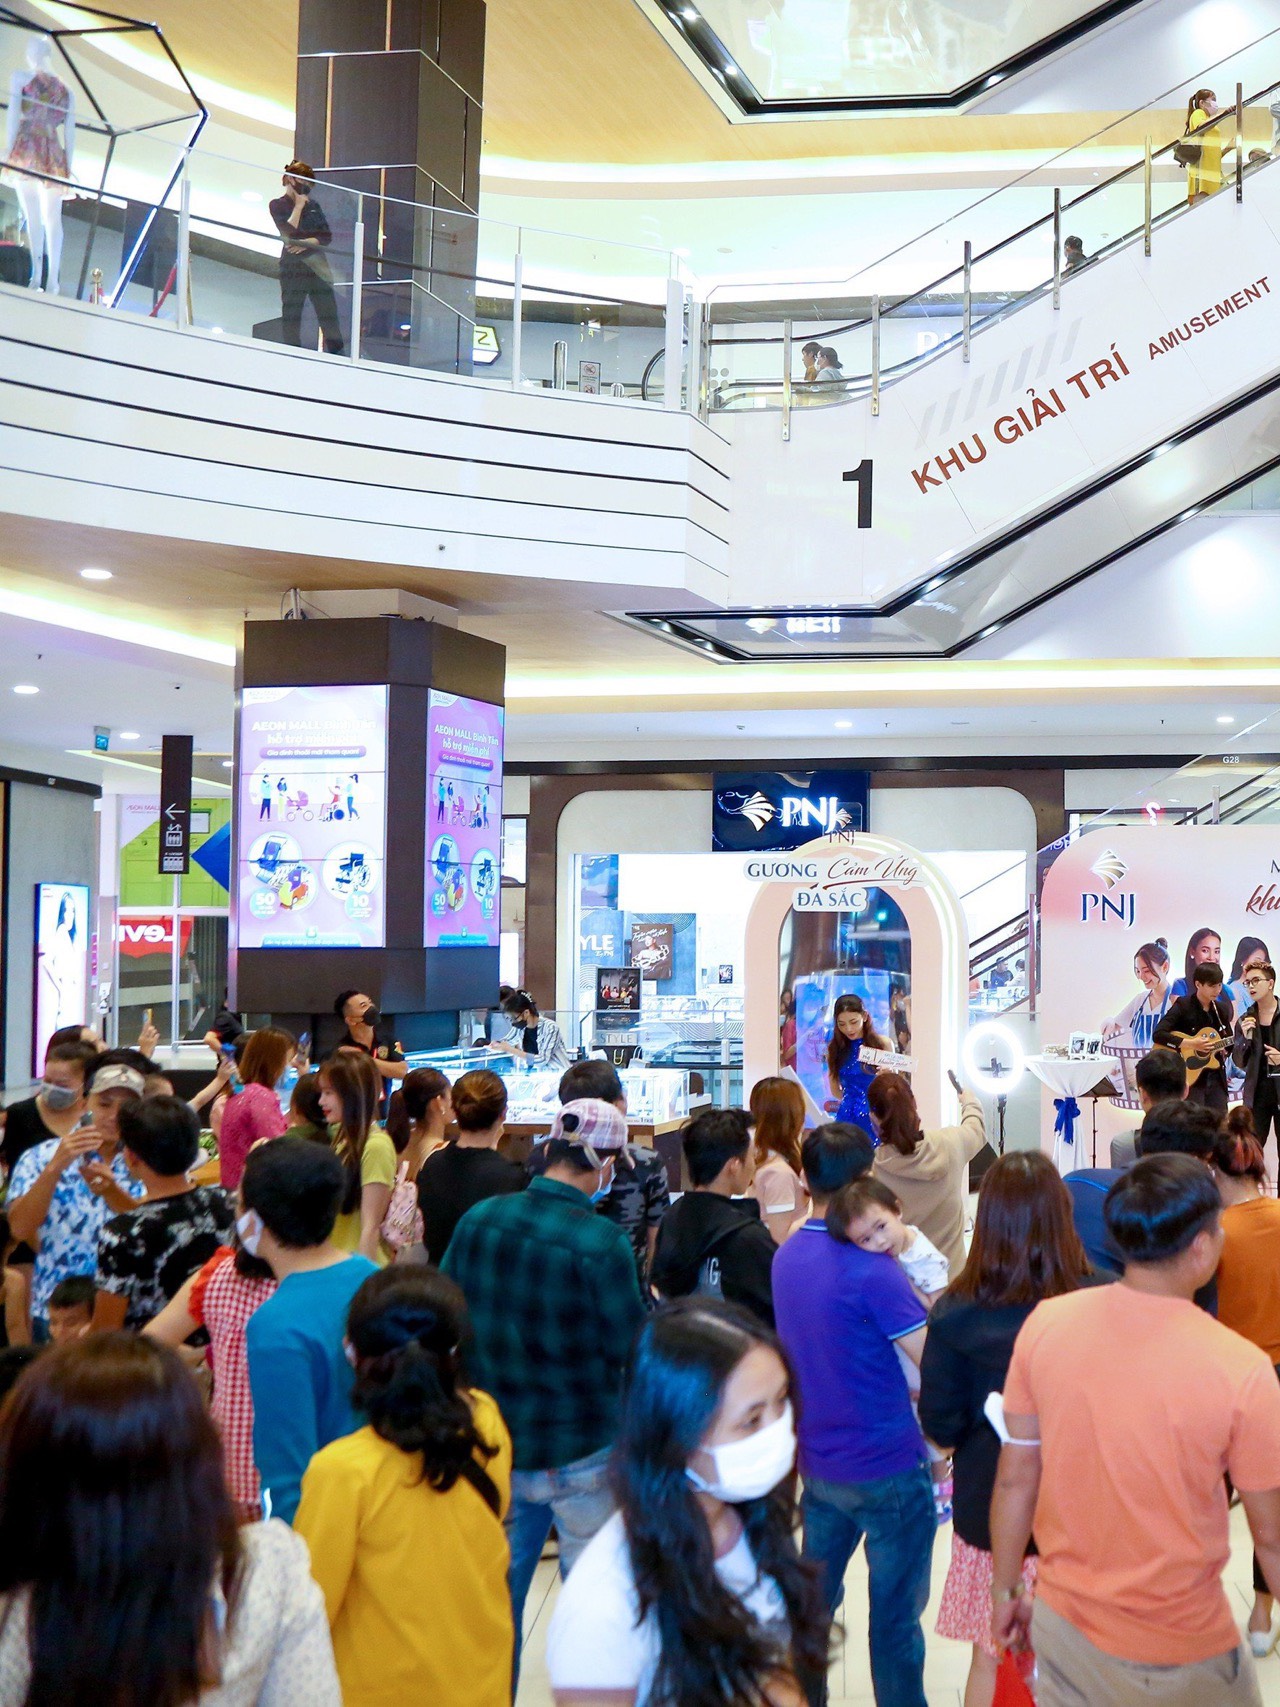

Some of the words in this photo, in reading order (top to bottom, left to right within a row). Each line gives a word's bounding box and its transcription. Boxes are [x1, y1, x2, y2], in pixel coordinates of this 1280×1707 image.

[911, 433, 988, 494] KHU
[993, 388, 1067, 445] GIẢI
[1067, 342, 1131, 400] TRÍ
[1146, 275, 1274, 361] AMUSEMENT
[842, 459, 873, 529] 1
[252, 720, 286, 731] AEON
[288, 719, 322, 730] MALL
[435, 724, 454, 737] AEON
[454, 728, 472, 740] MALL
[1222, 756, 1240, 764] G28
[781, 797, 839, 833] PNJ
[828, 829, 856, 845] PNJ
[747, 862, 817, 878] GƯƠNG
[827, 857, 869, 879] Cảm
[434, 893, 446, 906] 50
[485, 897, 493, 910] 10
[828, 887, 862, 906] SẮC
[1080, 892, 1136, 929] PNJ
